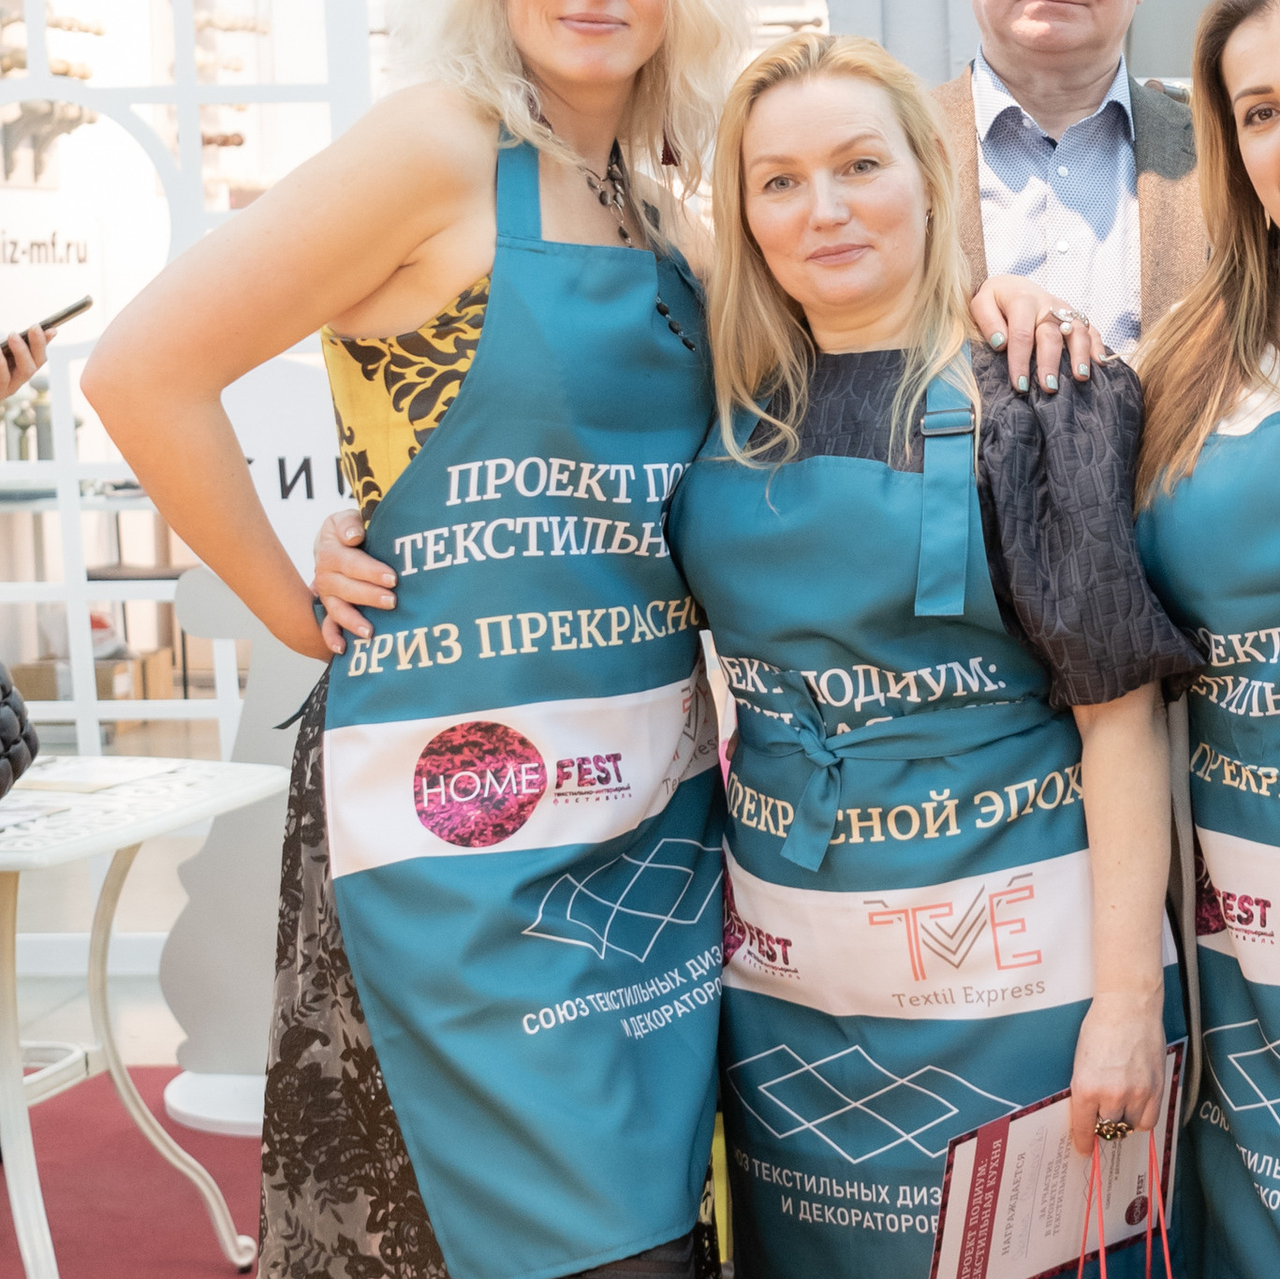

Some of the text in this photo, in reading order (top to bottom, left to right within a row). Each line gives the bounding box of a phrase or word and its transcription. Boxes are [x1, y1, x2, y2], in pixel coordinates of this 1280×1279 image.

[446, 456, 635, 506] ПРОЕКТ
[347, 622, 463, 678] БРИЗ
[421, 762, 541, 808] HOME
[555, 753, 622, 790] FEST
[744, 921, 793, 965] FEST
[522, 997, 590, 1035] СОЮЗ
[586, 968, 688, 1013] ТЕКСТИЛЬНЫХ
[892, 979, 1046, 1009] Textil Express
[620, 1018, 633, 1037] И
[752, 1158, 891, 1205] ТЕКСТИЛЬНЫХ
[986, 1138, 1001, 1186] КУХНЯ
[781, 1194, 794, 1216] И
[969, 1158, 987, 1225] ПОДИУМ:
[1002, 1152, 1024, 1255] НАГРАЖДАЕТСЯ
